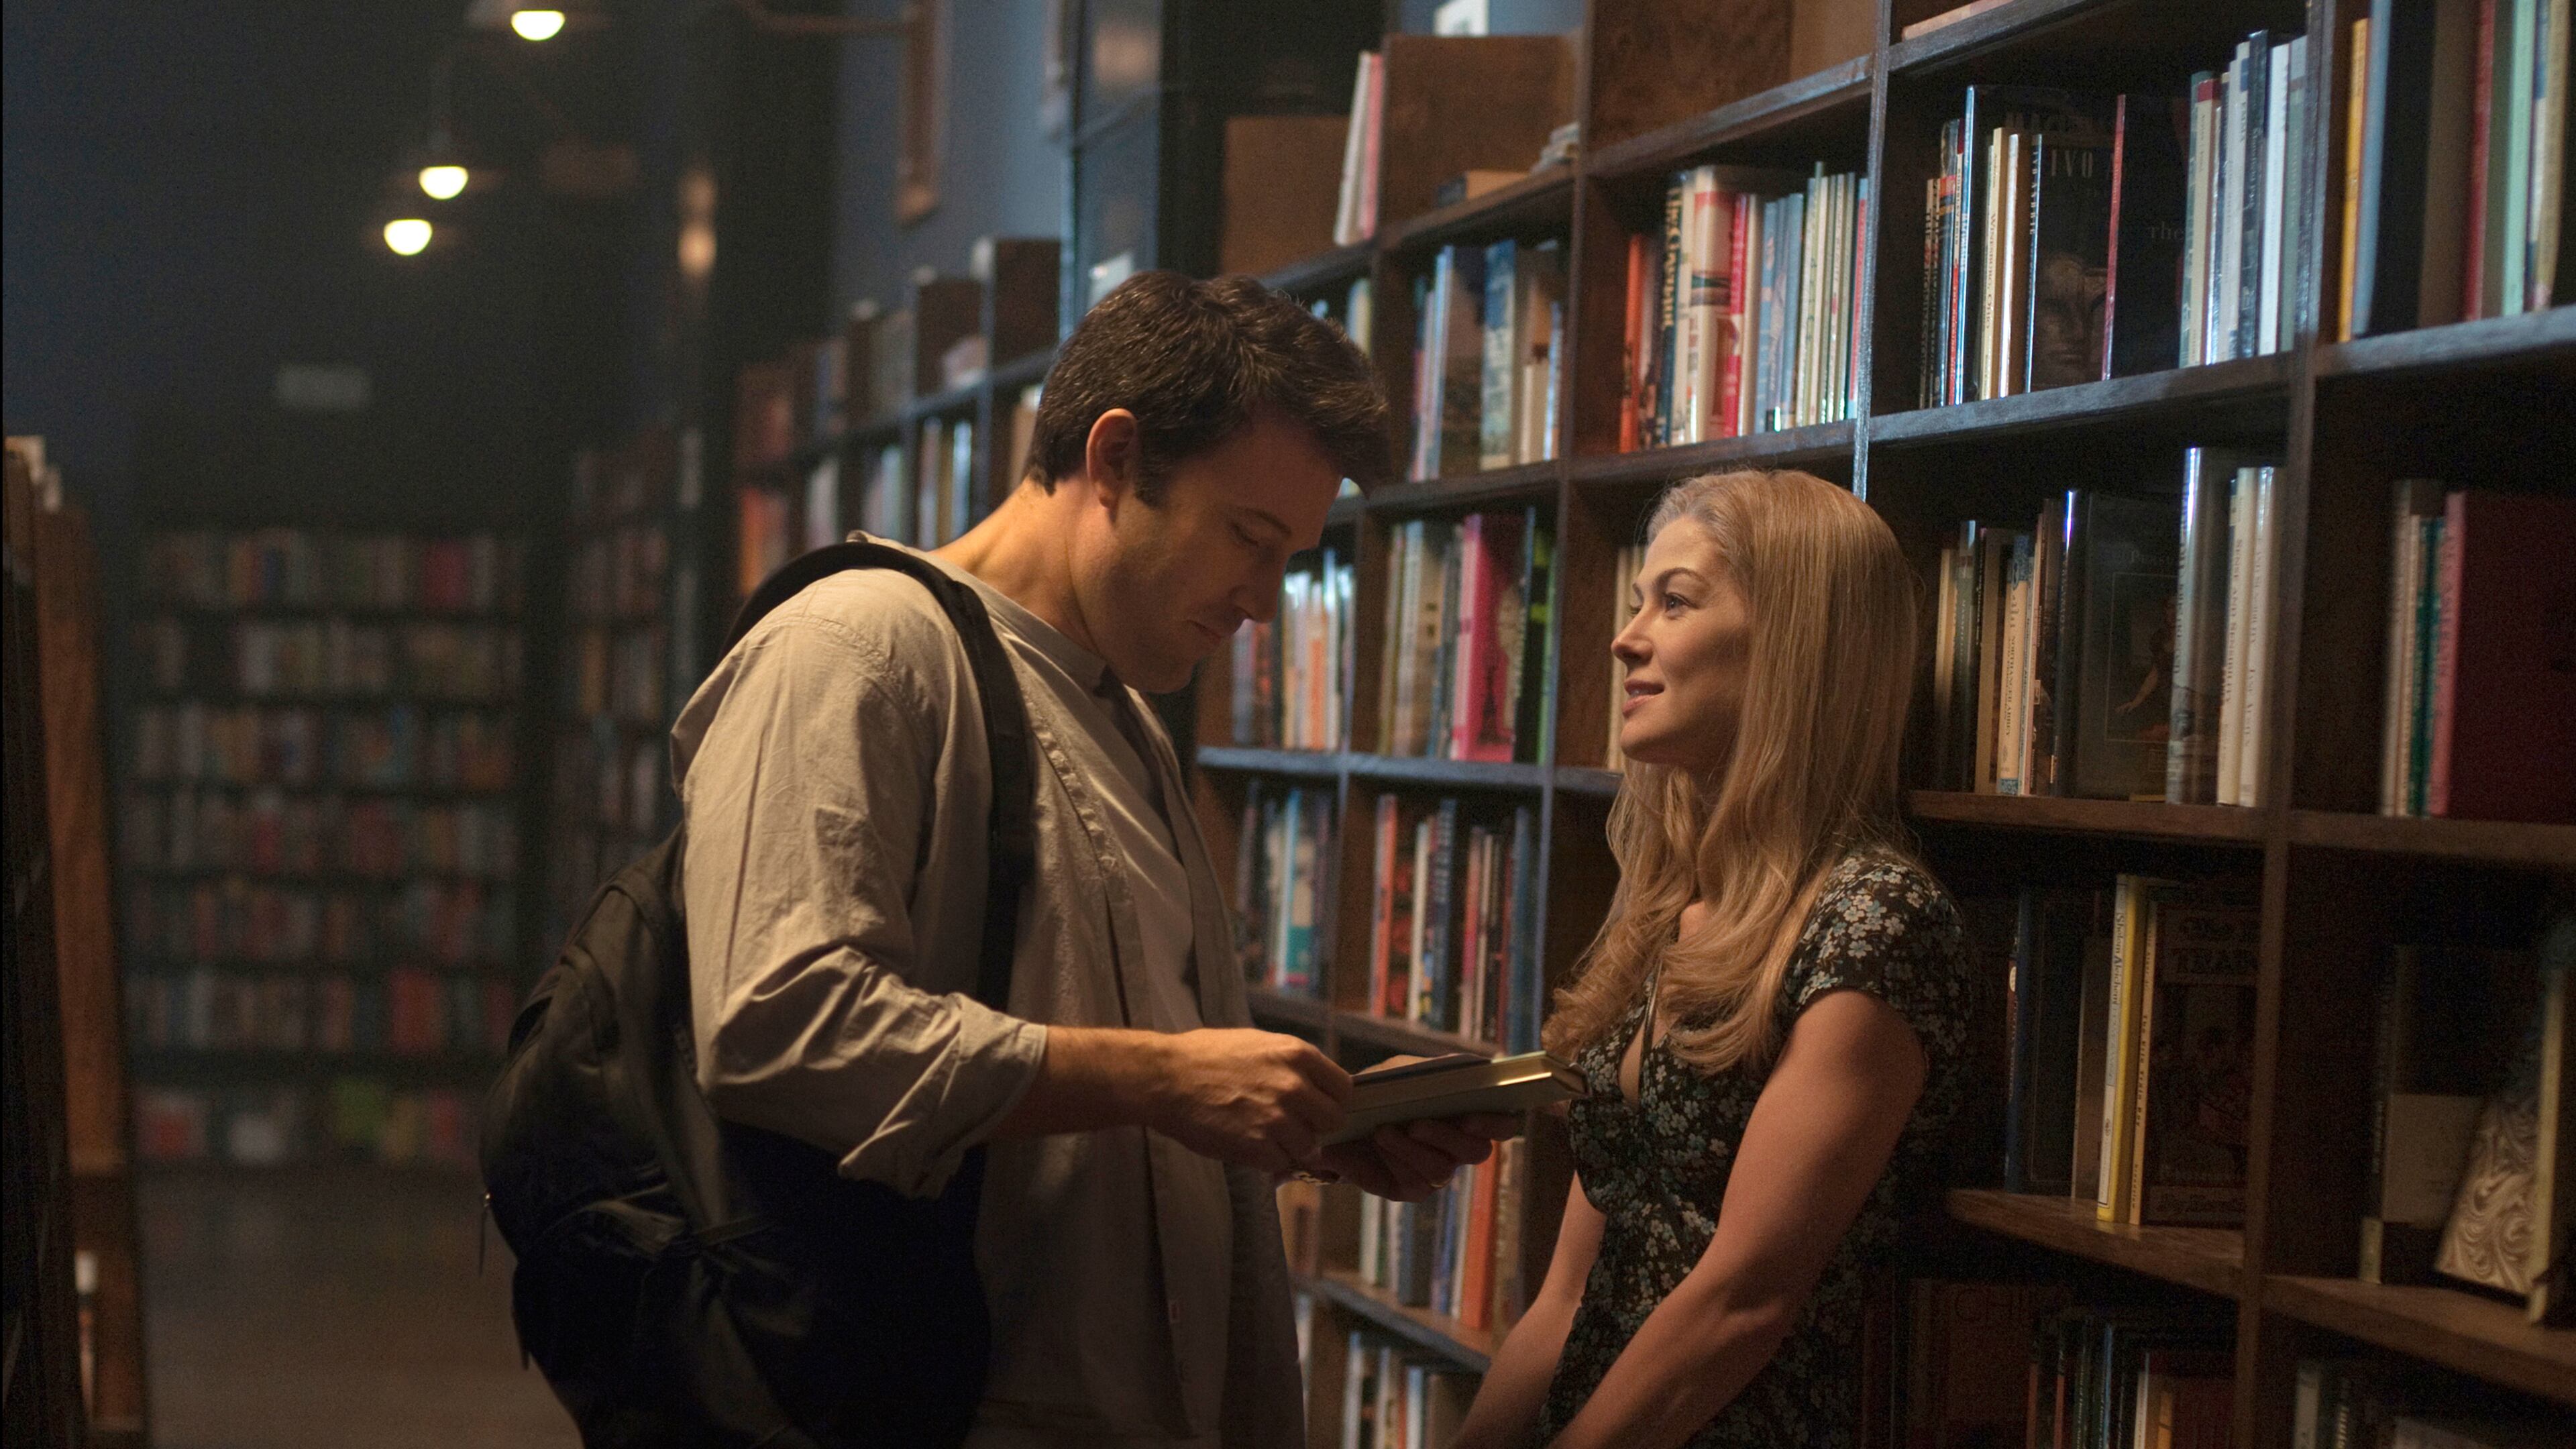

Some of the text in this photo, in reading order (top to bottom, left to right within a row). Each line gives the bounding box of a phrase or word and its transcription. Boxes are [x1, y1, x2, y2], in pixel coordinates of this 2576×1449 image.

[2051, 149, 2093, 178] IVO
[2234, 538, 2243, 580] SENSE
[2007, 635, 2015, 703] NORTHANGER
[2226, 621, 2237, 702] SENSIBILITY
[2114, 913, 2125, 954] Sholom
[2111, 955, 2123, 1005] Aleichem
